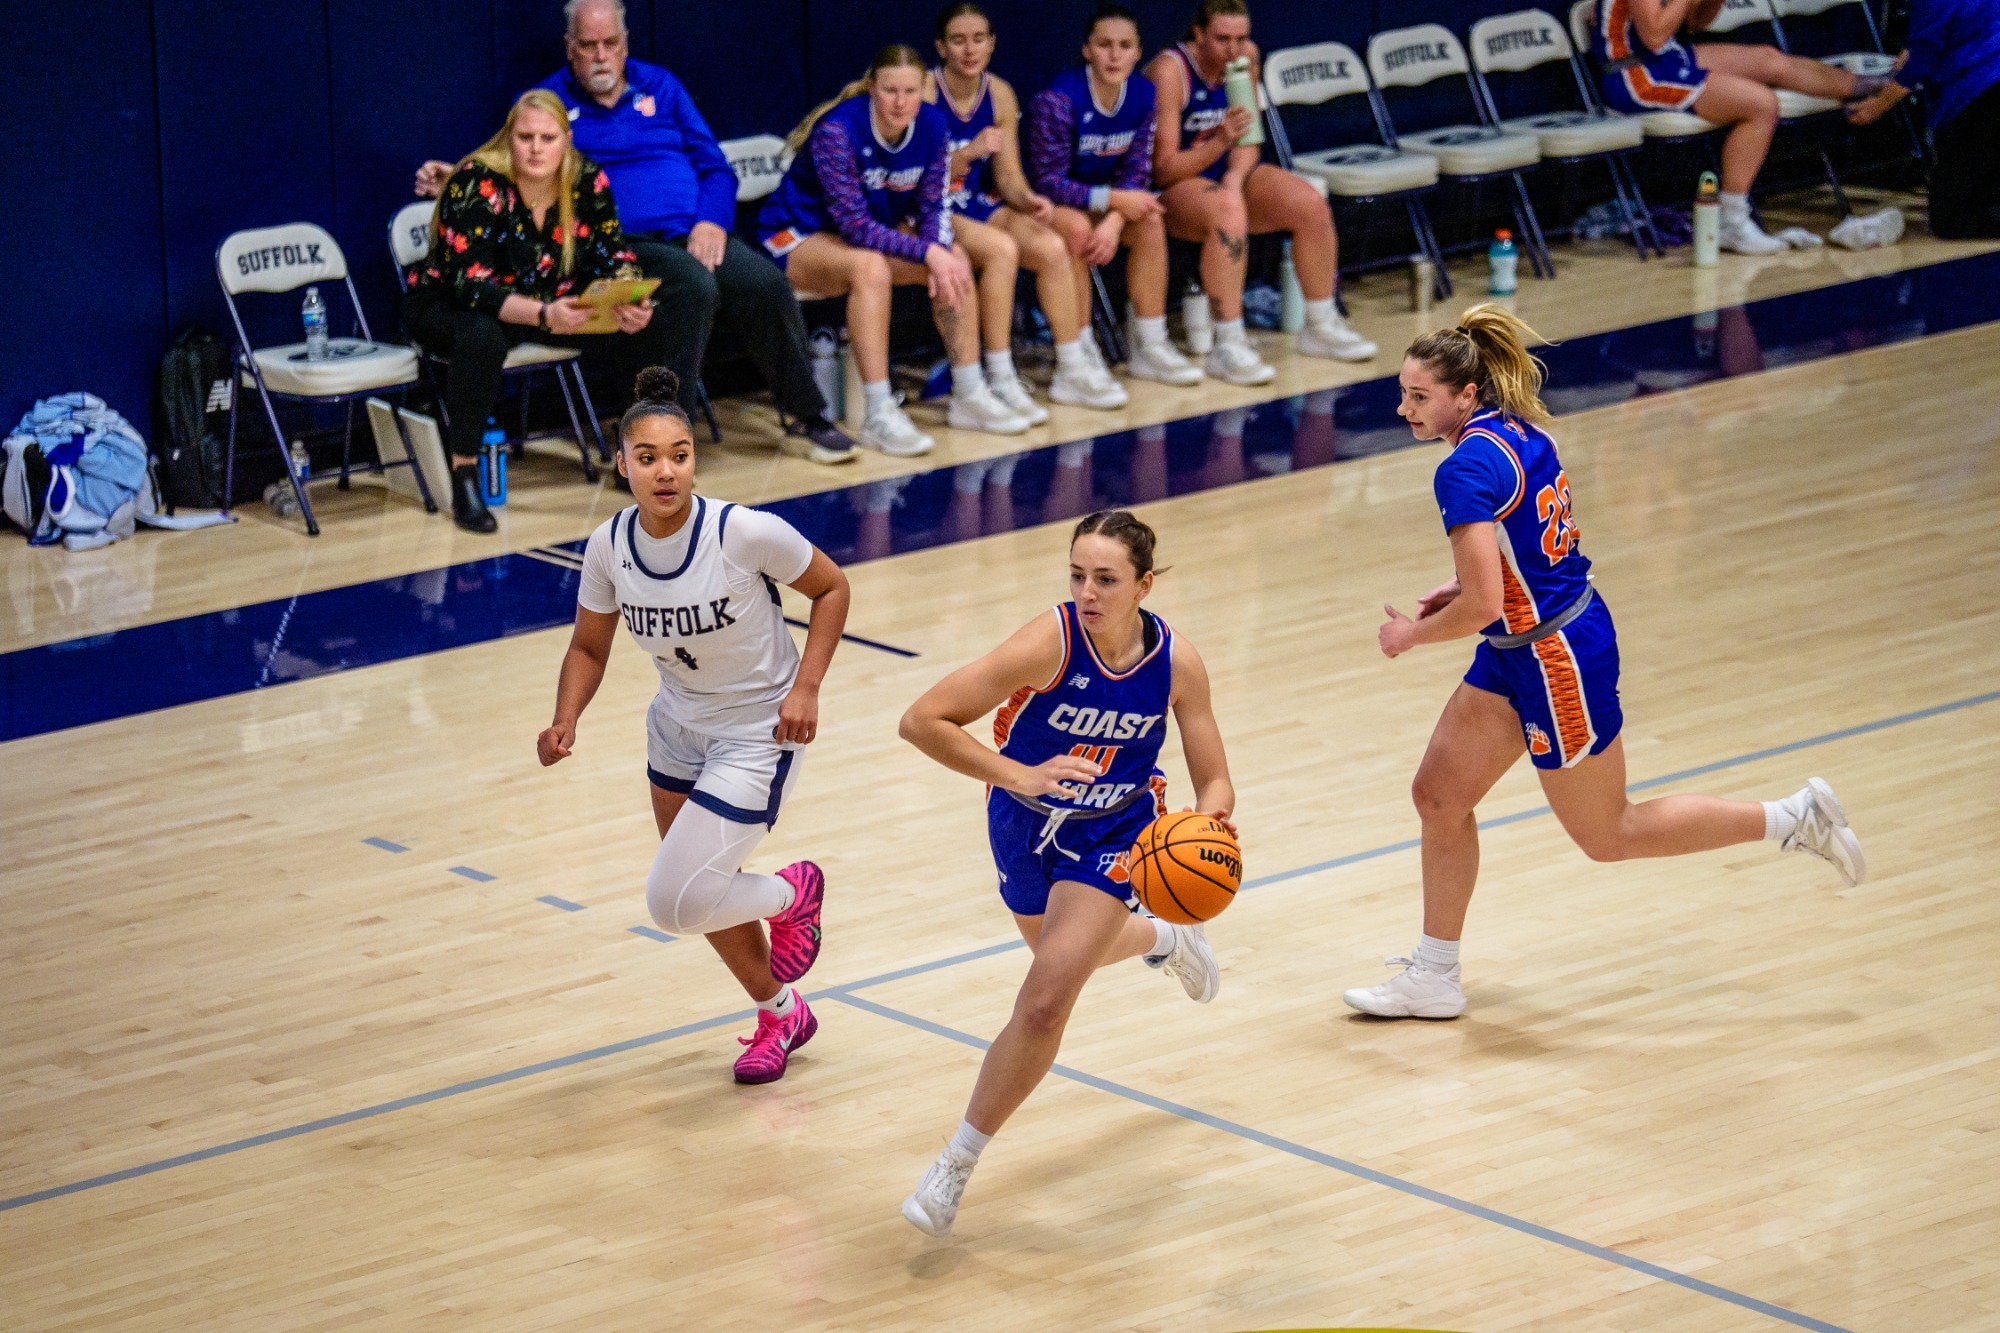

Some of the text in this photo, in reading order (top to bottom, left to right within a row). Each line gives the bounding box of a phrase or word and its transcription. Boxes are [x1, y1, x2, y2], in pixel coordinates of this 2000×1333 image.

[237, 243, 324, 276] SUFFOLK
[621, 596, 737, 638] SUFFOLK
[1047, 703, 1163, 740] COAST
